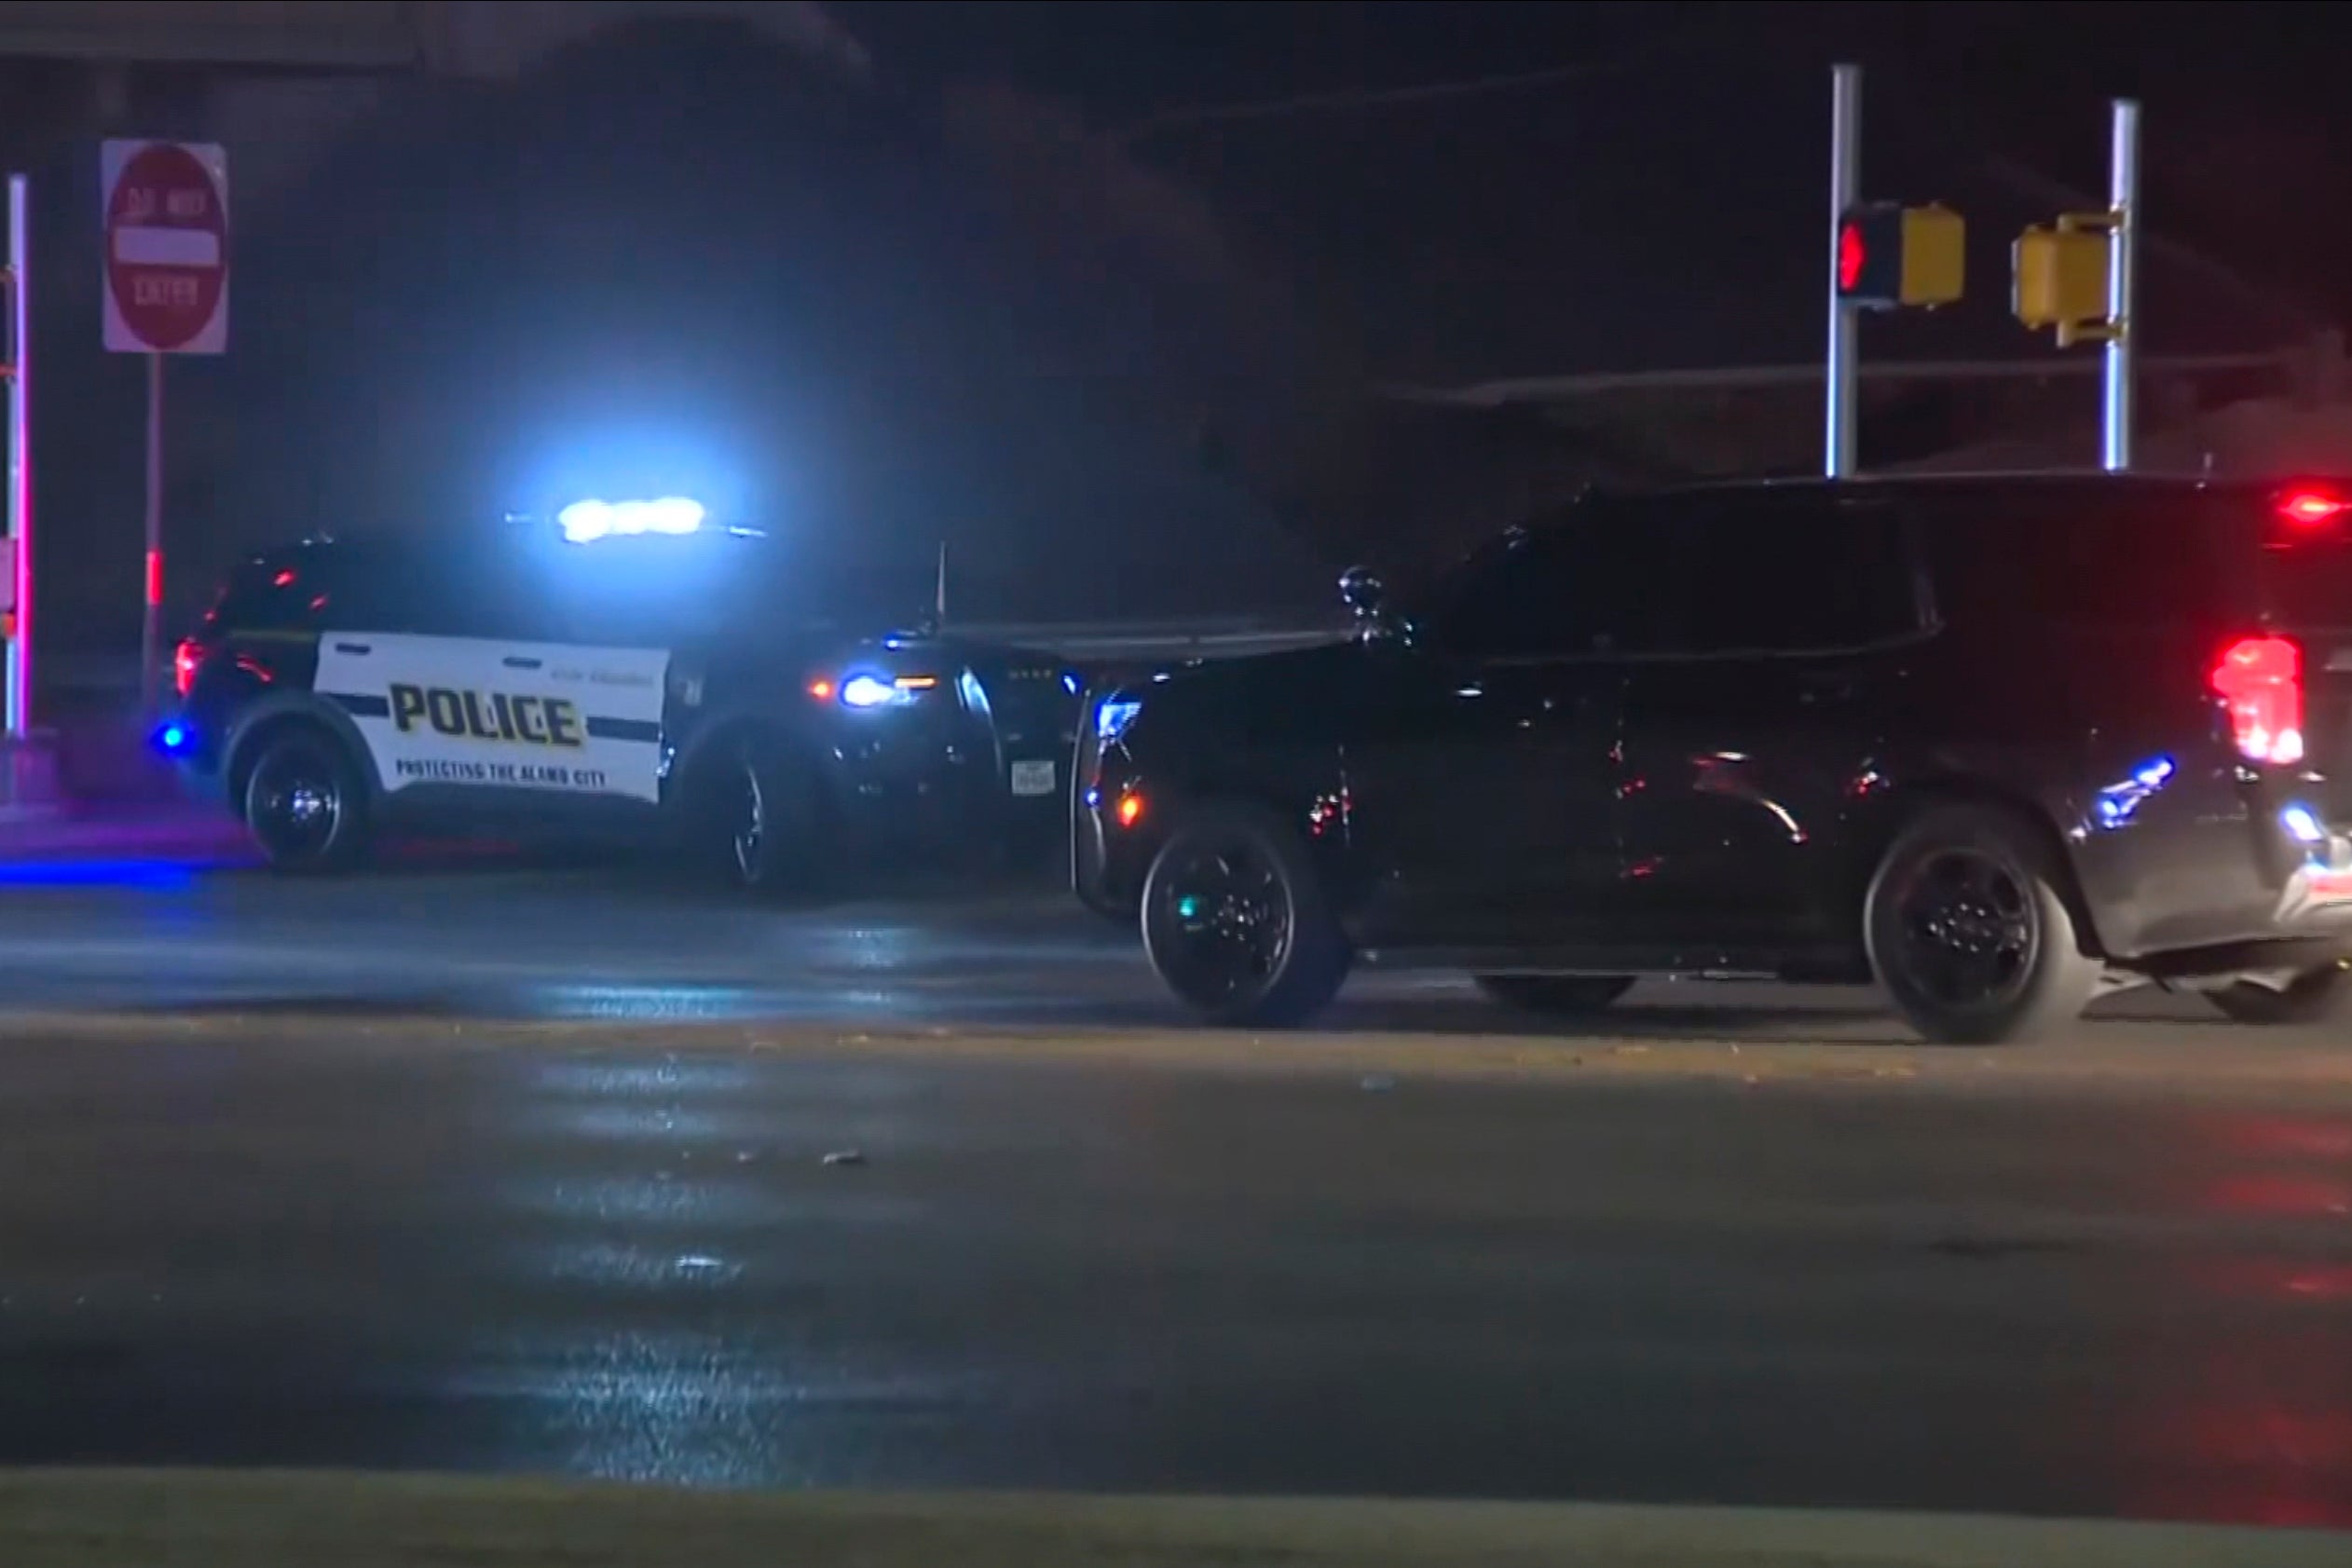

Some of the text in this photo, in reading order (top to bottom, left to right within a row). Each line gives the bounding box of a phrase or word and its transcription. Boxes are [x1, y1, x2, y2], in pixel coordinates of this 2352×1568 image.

[389, 683, 583, 747] POLICE
[395, 758, 607, 787] PROTECTING THE ALAMO CITY
